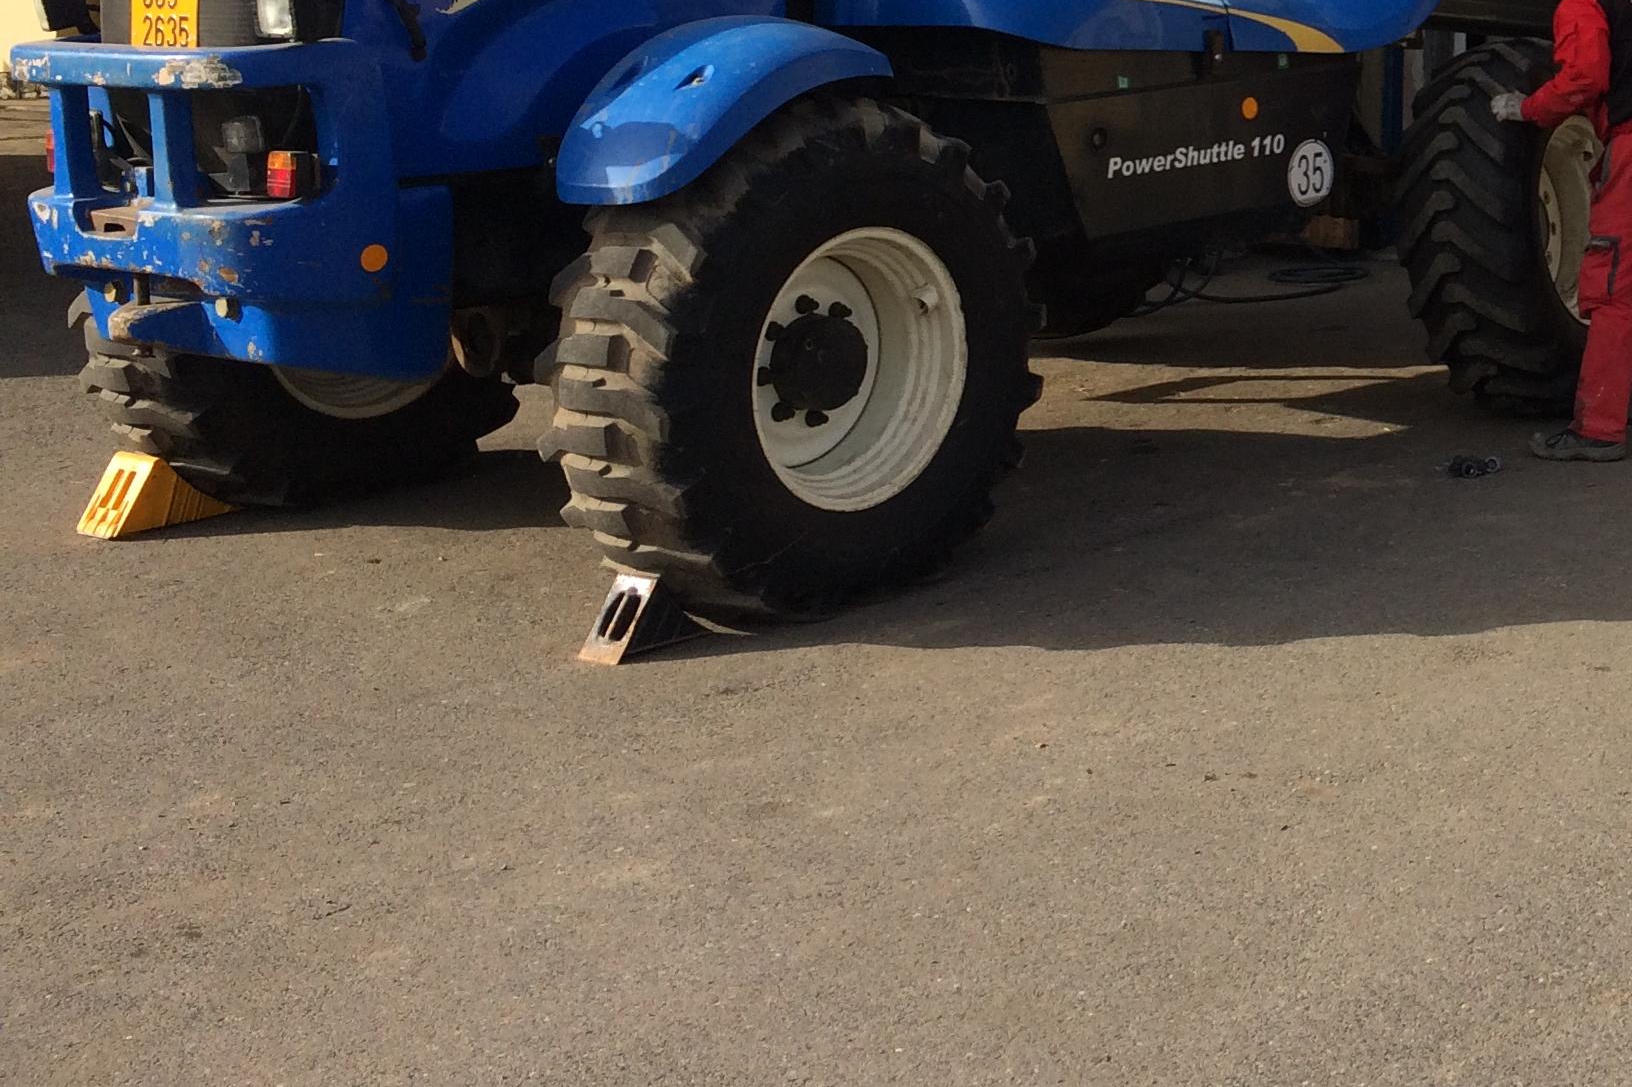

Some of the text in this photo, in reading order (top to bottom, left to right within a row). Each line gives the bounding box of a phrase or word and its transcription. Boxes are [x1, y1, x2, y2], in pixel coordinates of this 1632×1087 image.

[143, 15, 189, 48] 2635
[1107, 133, 1286, 179] PowerShuttle 110
[1297, 151, 1324, 196] 35
